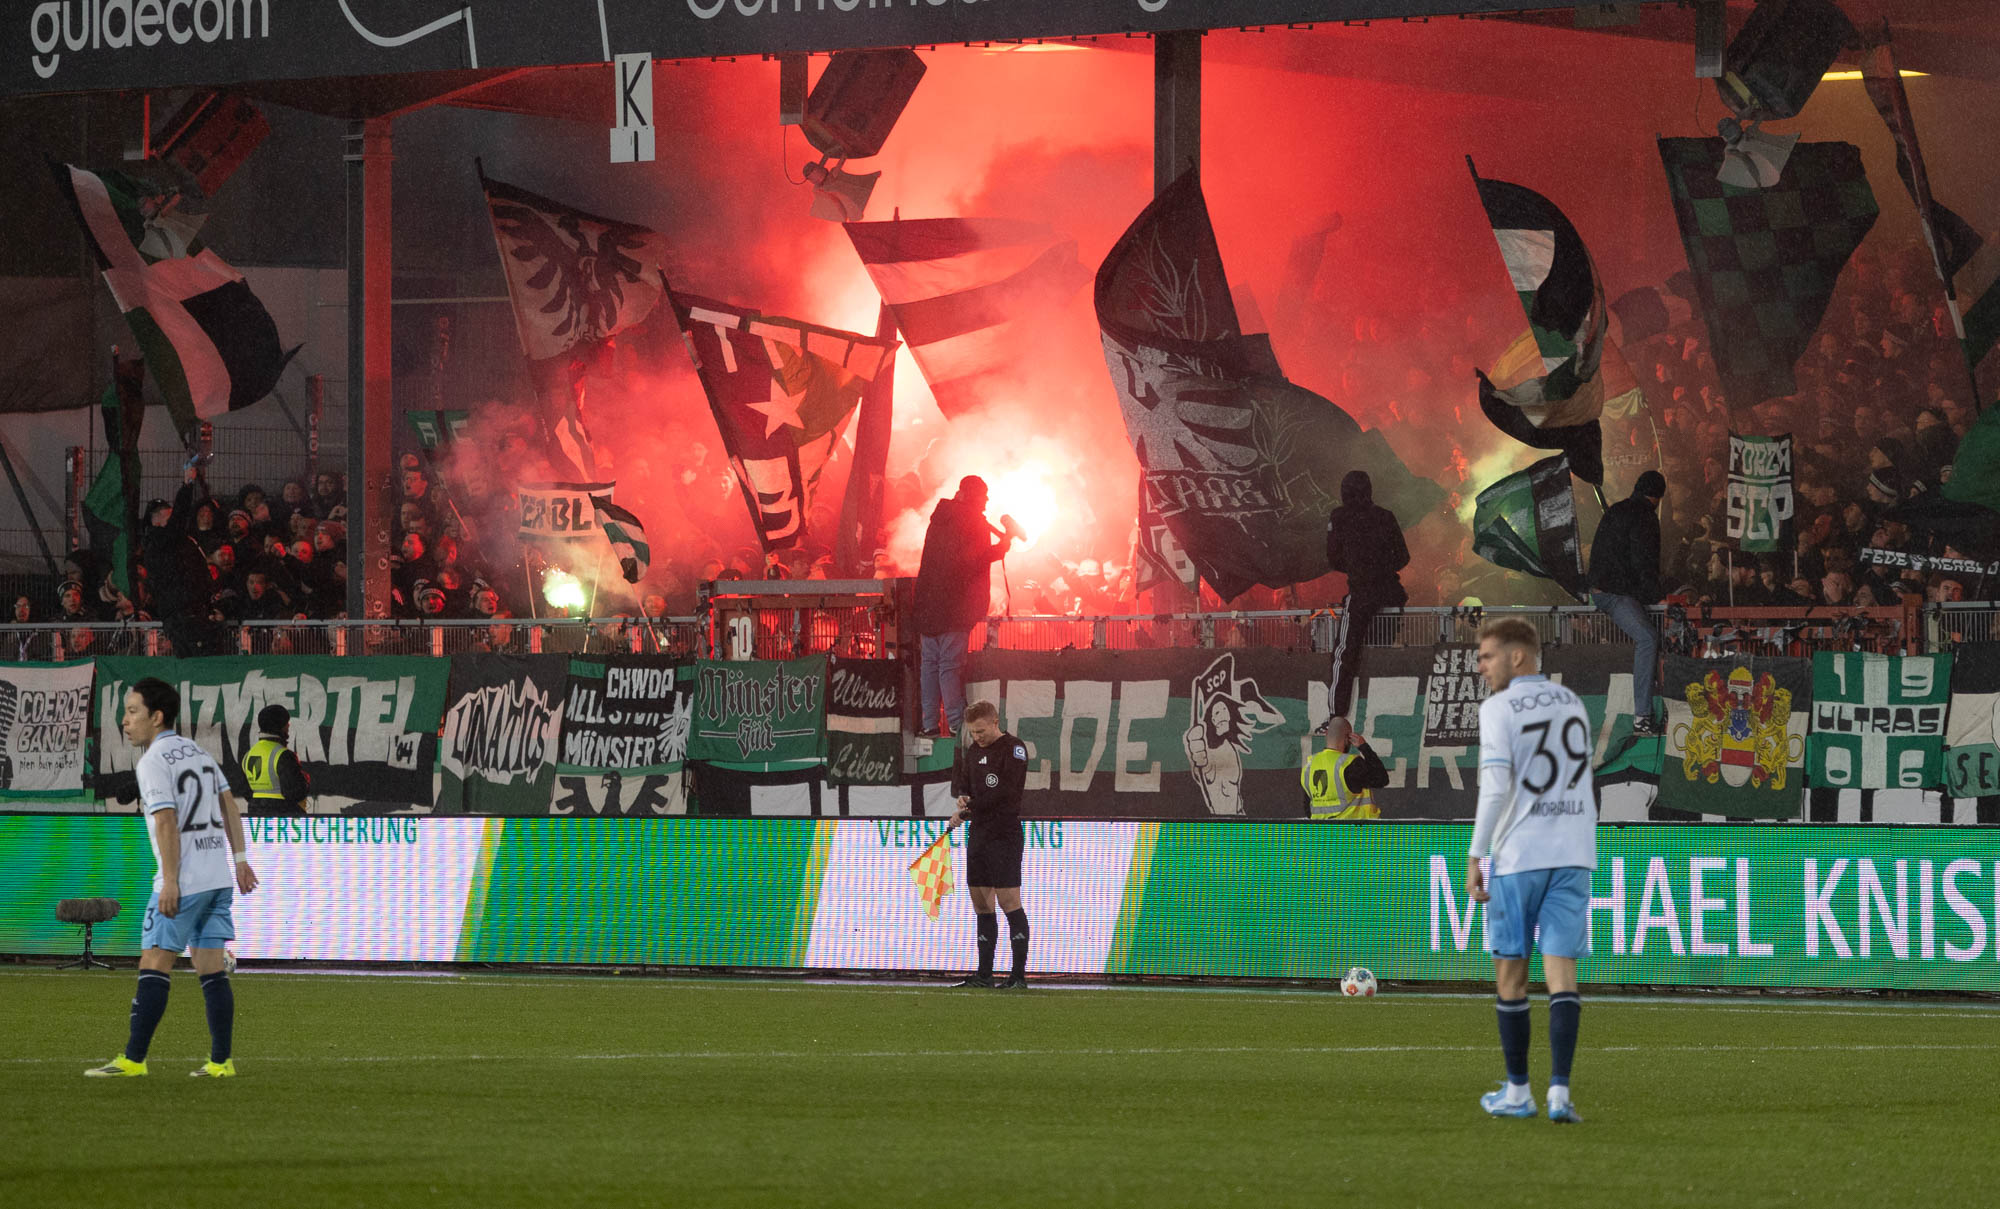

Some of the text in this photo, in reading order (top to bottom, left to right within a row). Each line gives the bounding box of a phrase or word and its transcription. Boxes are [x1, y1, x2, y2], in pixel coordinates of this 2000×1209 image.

[622, 60, 647, 127] K
[1728, 436, 1791, 476] FORZA
[1726, 482, 1794, 540] SCP
[1859, 547, 1908, 567] FEDE
[729, 616, 752, 661] 10
[606, 667, 675, 699] CHWDP
[831, 669, 897, 710] Ultras
[1206, 670, 1226, 693] SCP
[1817, 704, 1940, 734] ULTRAS
[563, 729, 656, 769] MÜNSTER
[830, 743, 894, 782] Liberi
[1521, 717, 1587, 795] 39
[1956, 751, 2000, 791] SE
[249, 817, 418, 844] VERSICHERUNG
[1429, 855, 2000, 961] MHAEL KNIS
